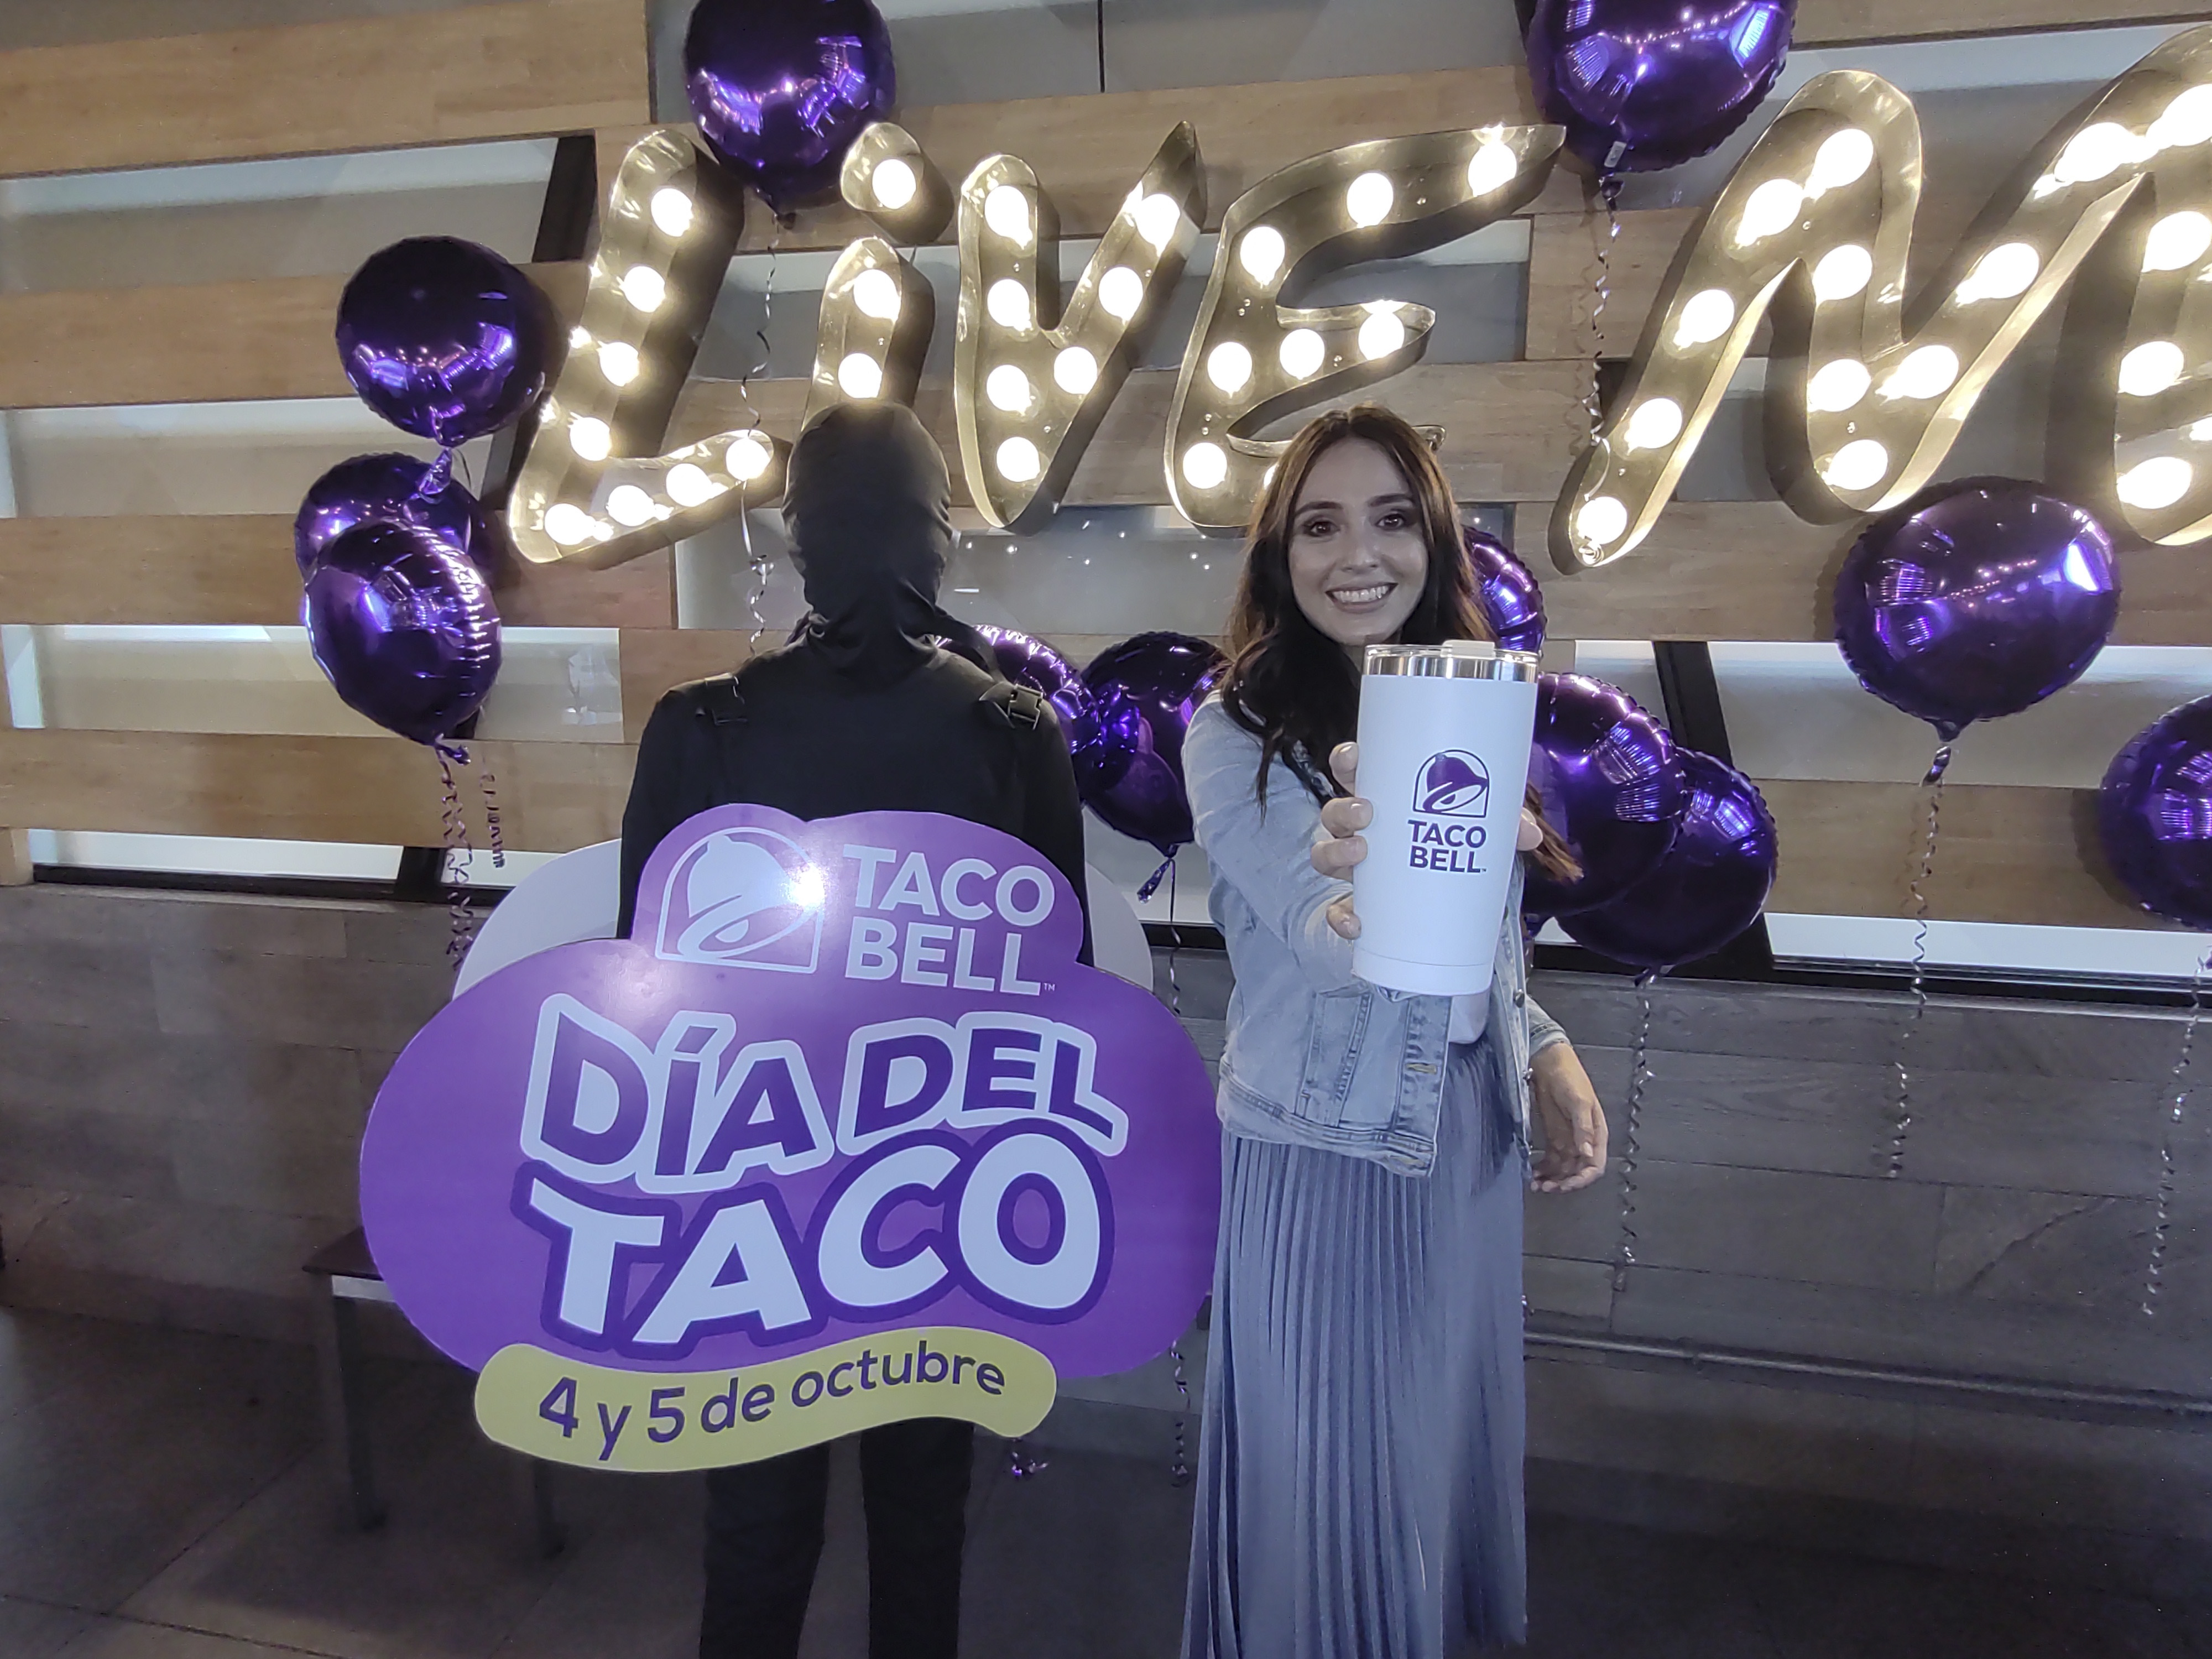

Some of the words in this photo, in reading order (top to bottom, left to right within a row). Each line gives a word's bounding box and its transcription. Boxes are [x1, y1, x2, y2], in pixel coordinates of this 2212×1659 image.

[1407, 820, 1486, 848] TACO
[1410, 845, 1481, 873] BELL
[843, 844, 1055, 927] TACO
[845, 916, 1041, 996] BELL
[836, 1012, 1127, 1156] DEL
[529, 1132, 1102, 1344] TACO
[539, 1376, 579, 1438] 4
[597, 1401, 632, 1460] y
[647, 1386, 685, 1443] 5
[700, 1378, 775, 1433] de
[791, 1340, 1005, 1408] octubre
